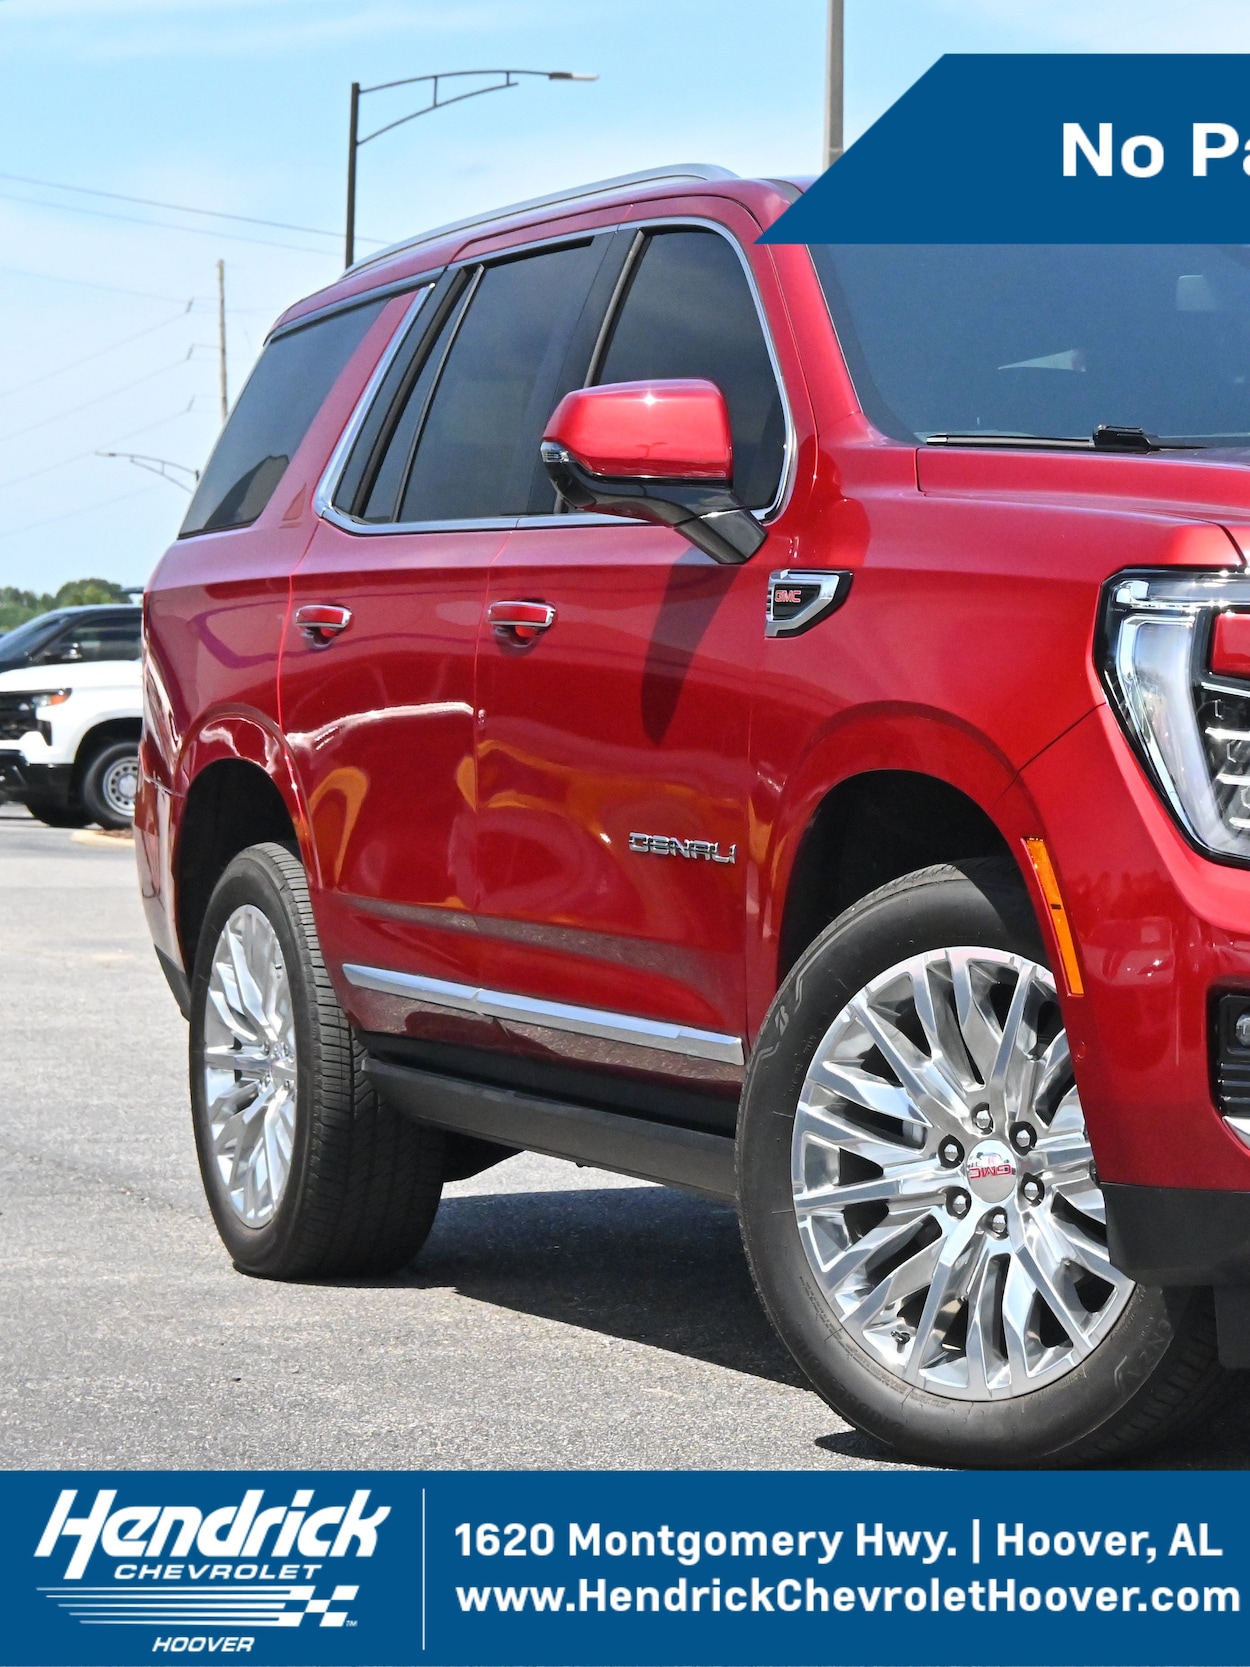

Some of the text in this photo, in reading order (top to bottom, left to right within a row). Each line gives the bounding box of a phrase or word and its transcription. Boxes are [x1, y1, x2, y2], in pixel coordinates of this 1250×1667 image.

[775, 590, 801, 603] GMC
[628, 832, 736, 864] DENALI
[969, 1164, 1012, 1179] GMC
